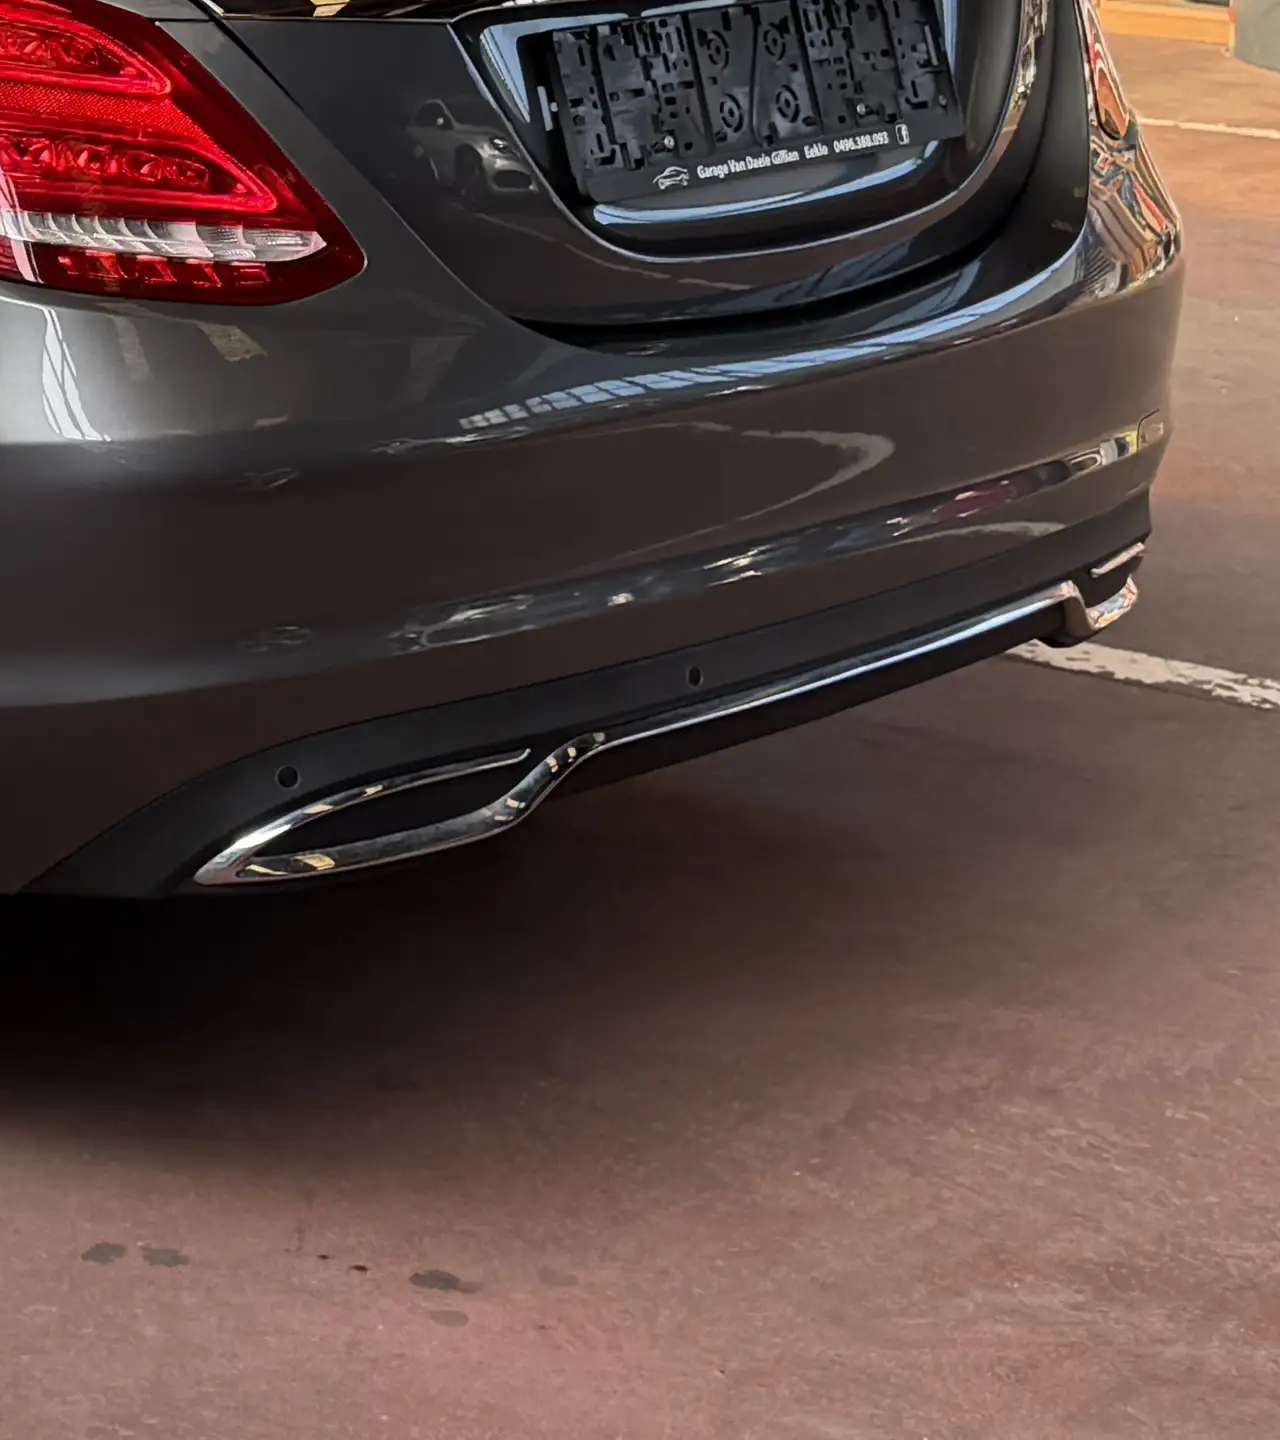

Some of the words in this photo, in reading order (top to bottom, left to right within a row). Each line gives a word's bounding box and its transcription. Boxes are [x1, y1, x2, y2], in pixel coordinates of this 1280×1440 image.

[697, 164, 728, 179] Garage
[727, 158, 746, 173] Van
[803, 143, 829, 159] Eeklo
